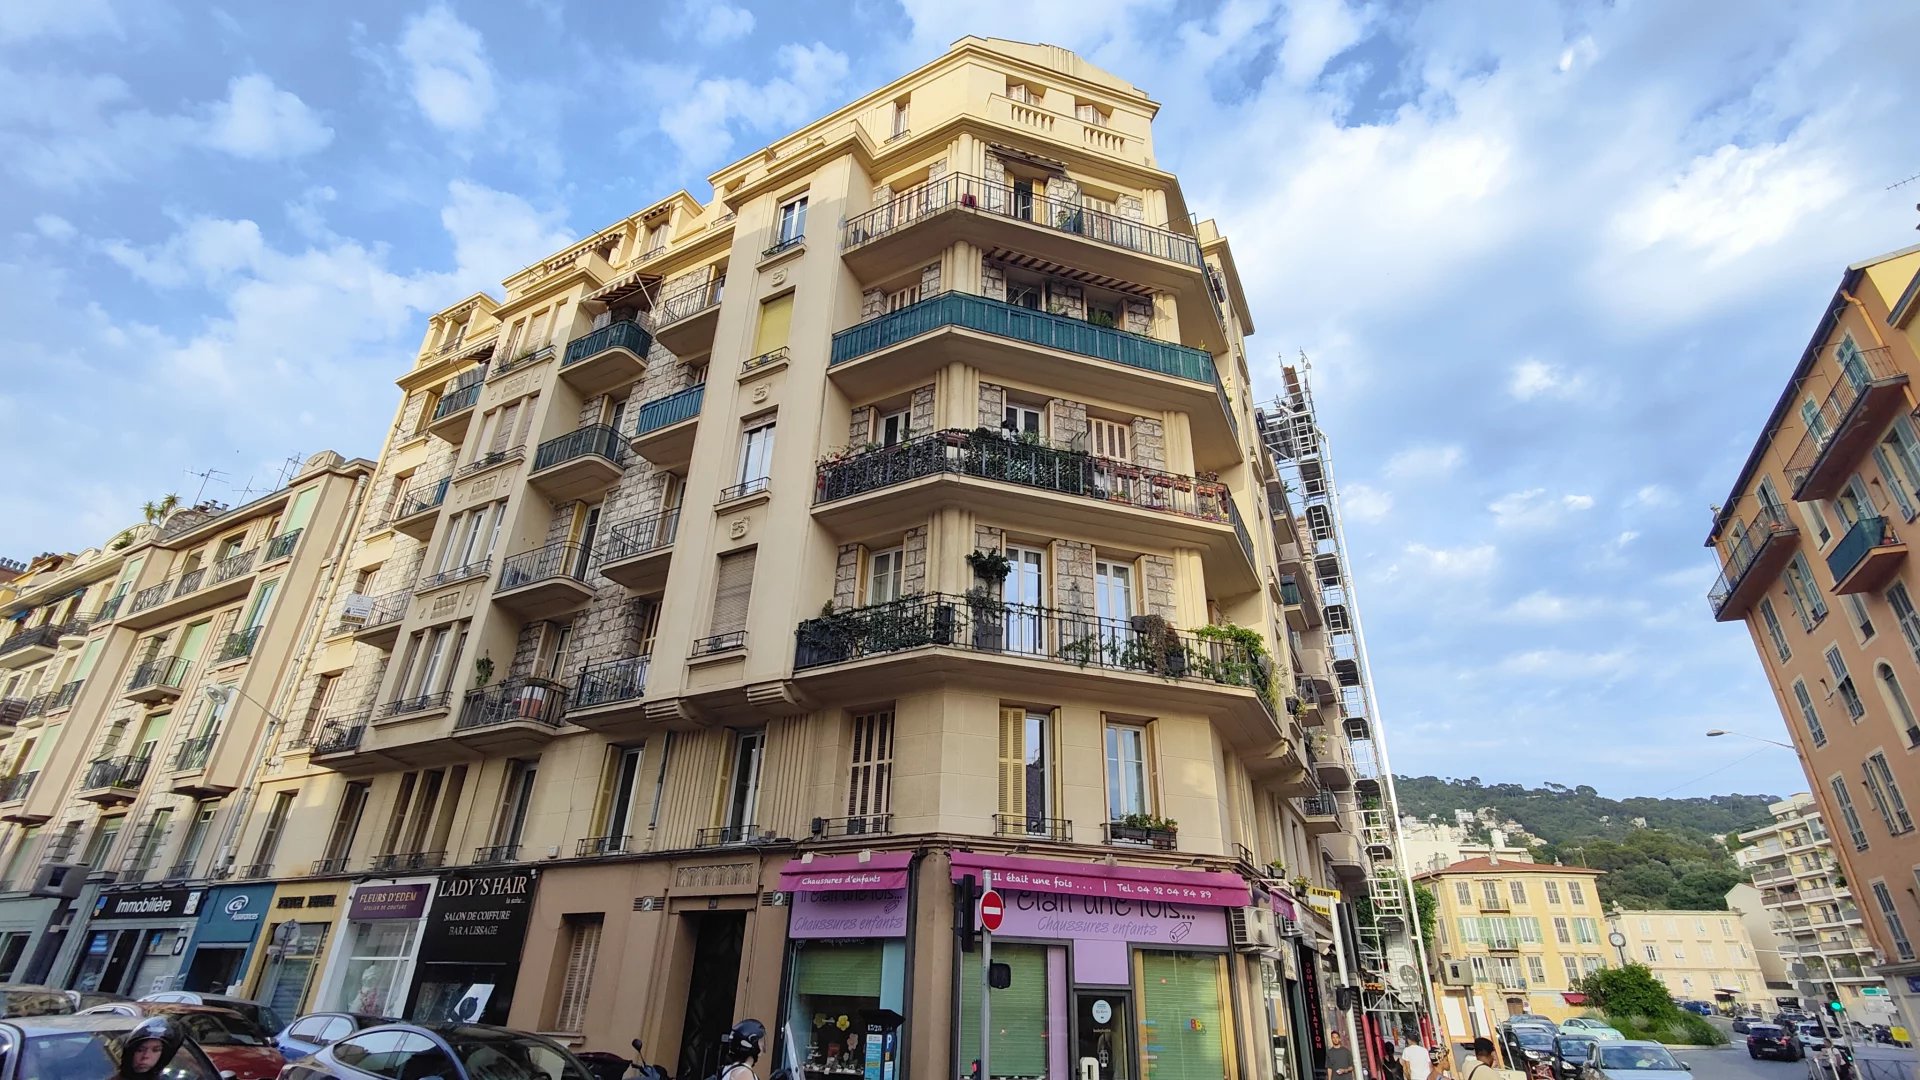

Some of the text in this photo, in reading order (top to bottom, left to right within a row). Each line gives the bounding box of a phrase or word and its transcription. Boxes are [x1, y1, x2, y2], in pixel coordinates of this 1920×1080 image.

[491, 876, 527, 894] HAIR
[801, 873, 881, 885] Chaussures d'enfants
[1006, 873, 1029, 884] était
[1032, 877, 1050, 886] une
[1117, 883, 1212, 899] Tel. 04 92 04 84 89
[115, 896, 172, 913] Immobilière
[360, 894, 387, 903] FLEURS
[644, 898, 651, 911] 2
[774, 892, 784, 905] 2
[444, 910, 511, 921] SALON DE COIFFURE
[794, 915, 903, 934] Chaussures enfants
[1037, 916, 1158, 938] Chaussures enfants
[886, 1034, 892, 1049] P
